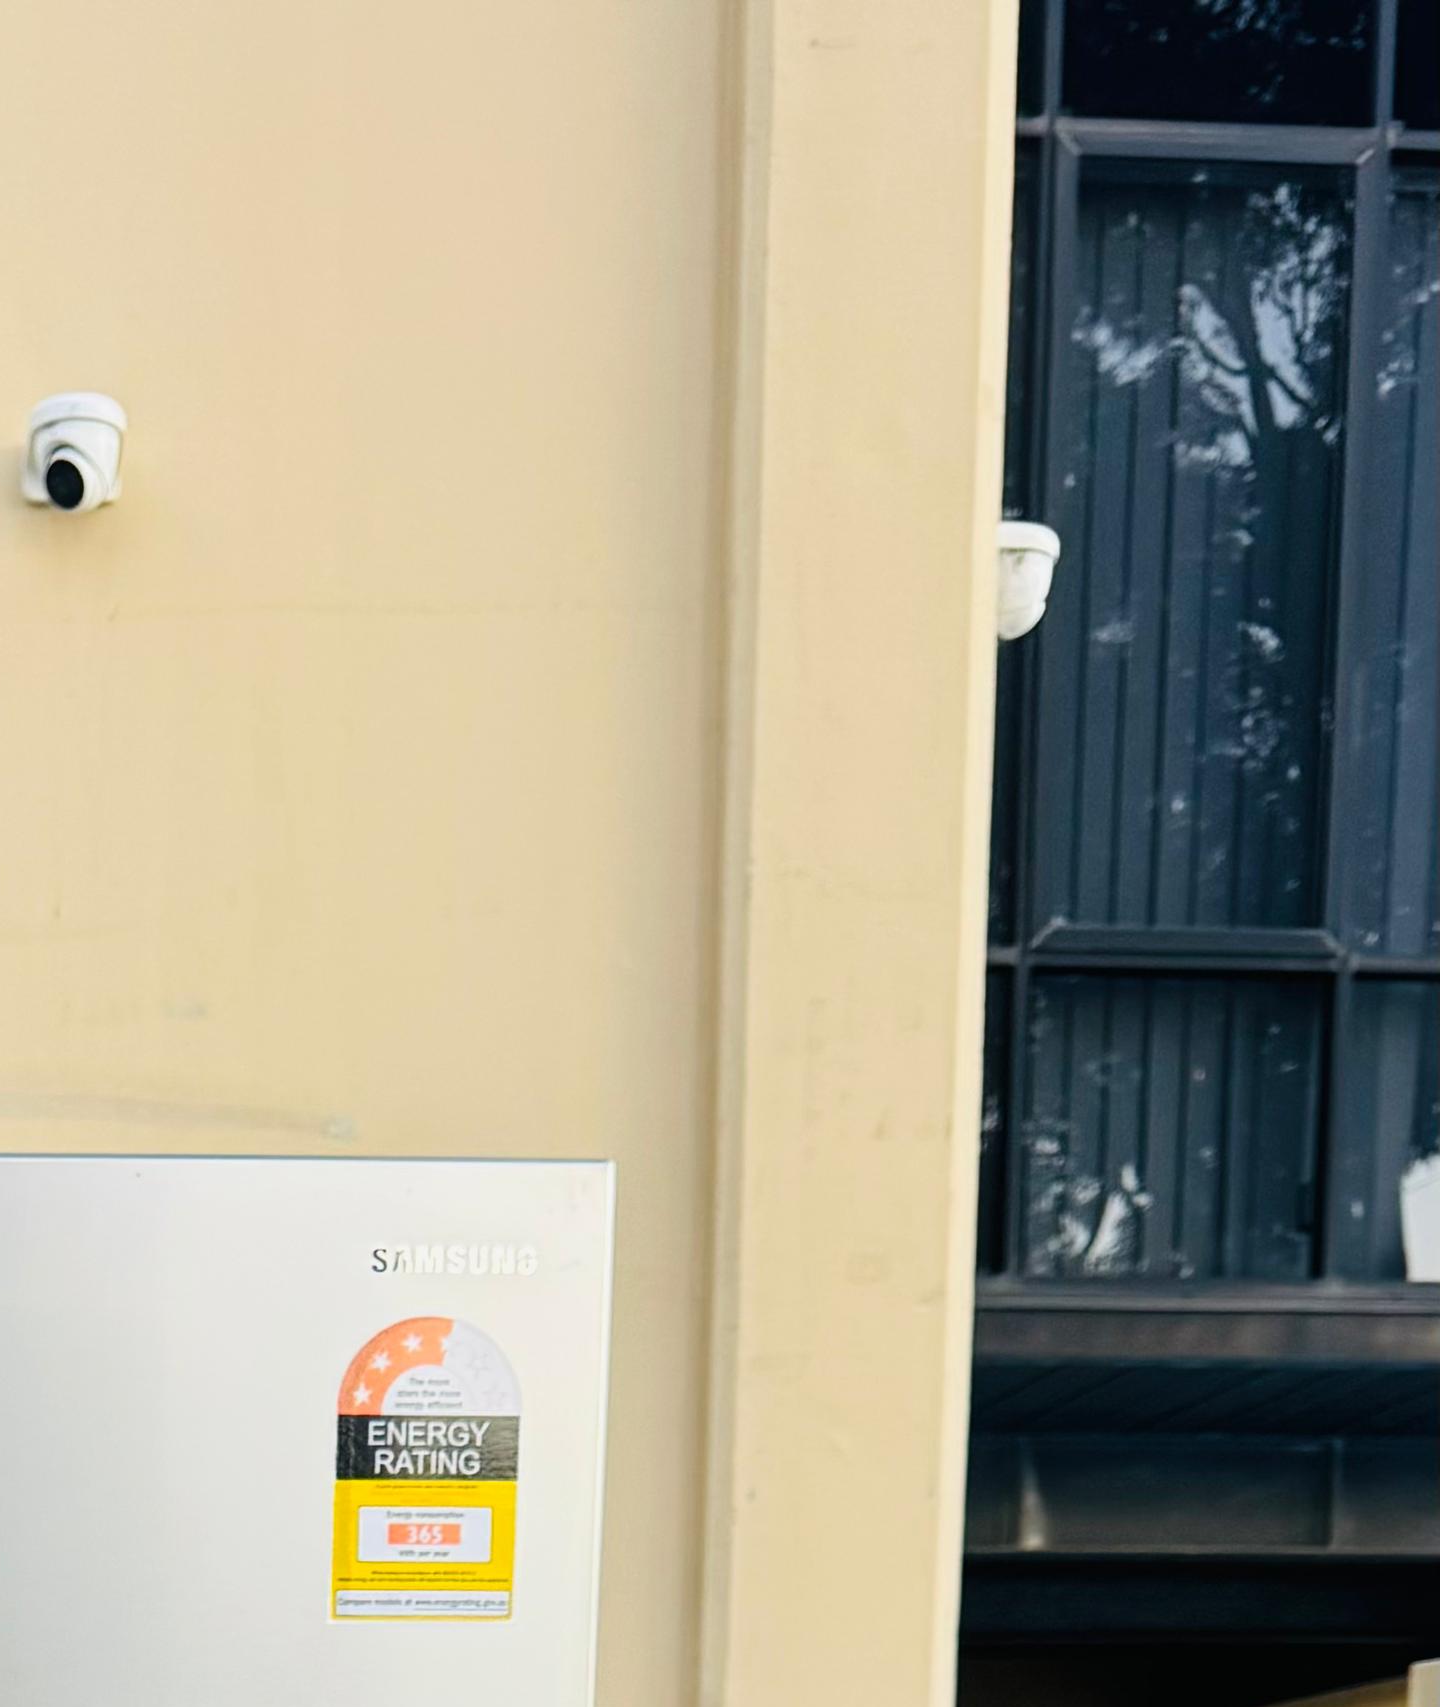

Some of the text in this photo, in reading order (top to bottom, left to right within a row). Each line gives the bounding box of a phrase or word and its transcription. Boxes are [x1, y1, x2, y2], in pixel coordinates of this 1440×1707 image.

[371, 1246, 539, 1276] SAMSUNG
[367, 1420, 491, 1448] ENERGY
[374, 1449, 482, 1476] RATING
[405, 1525, 444, 1545] 365
